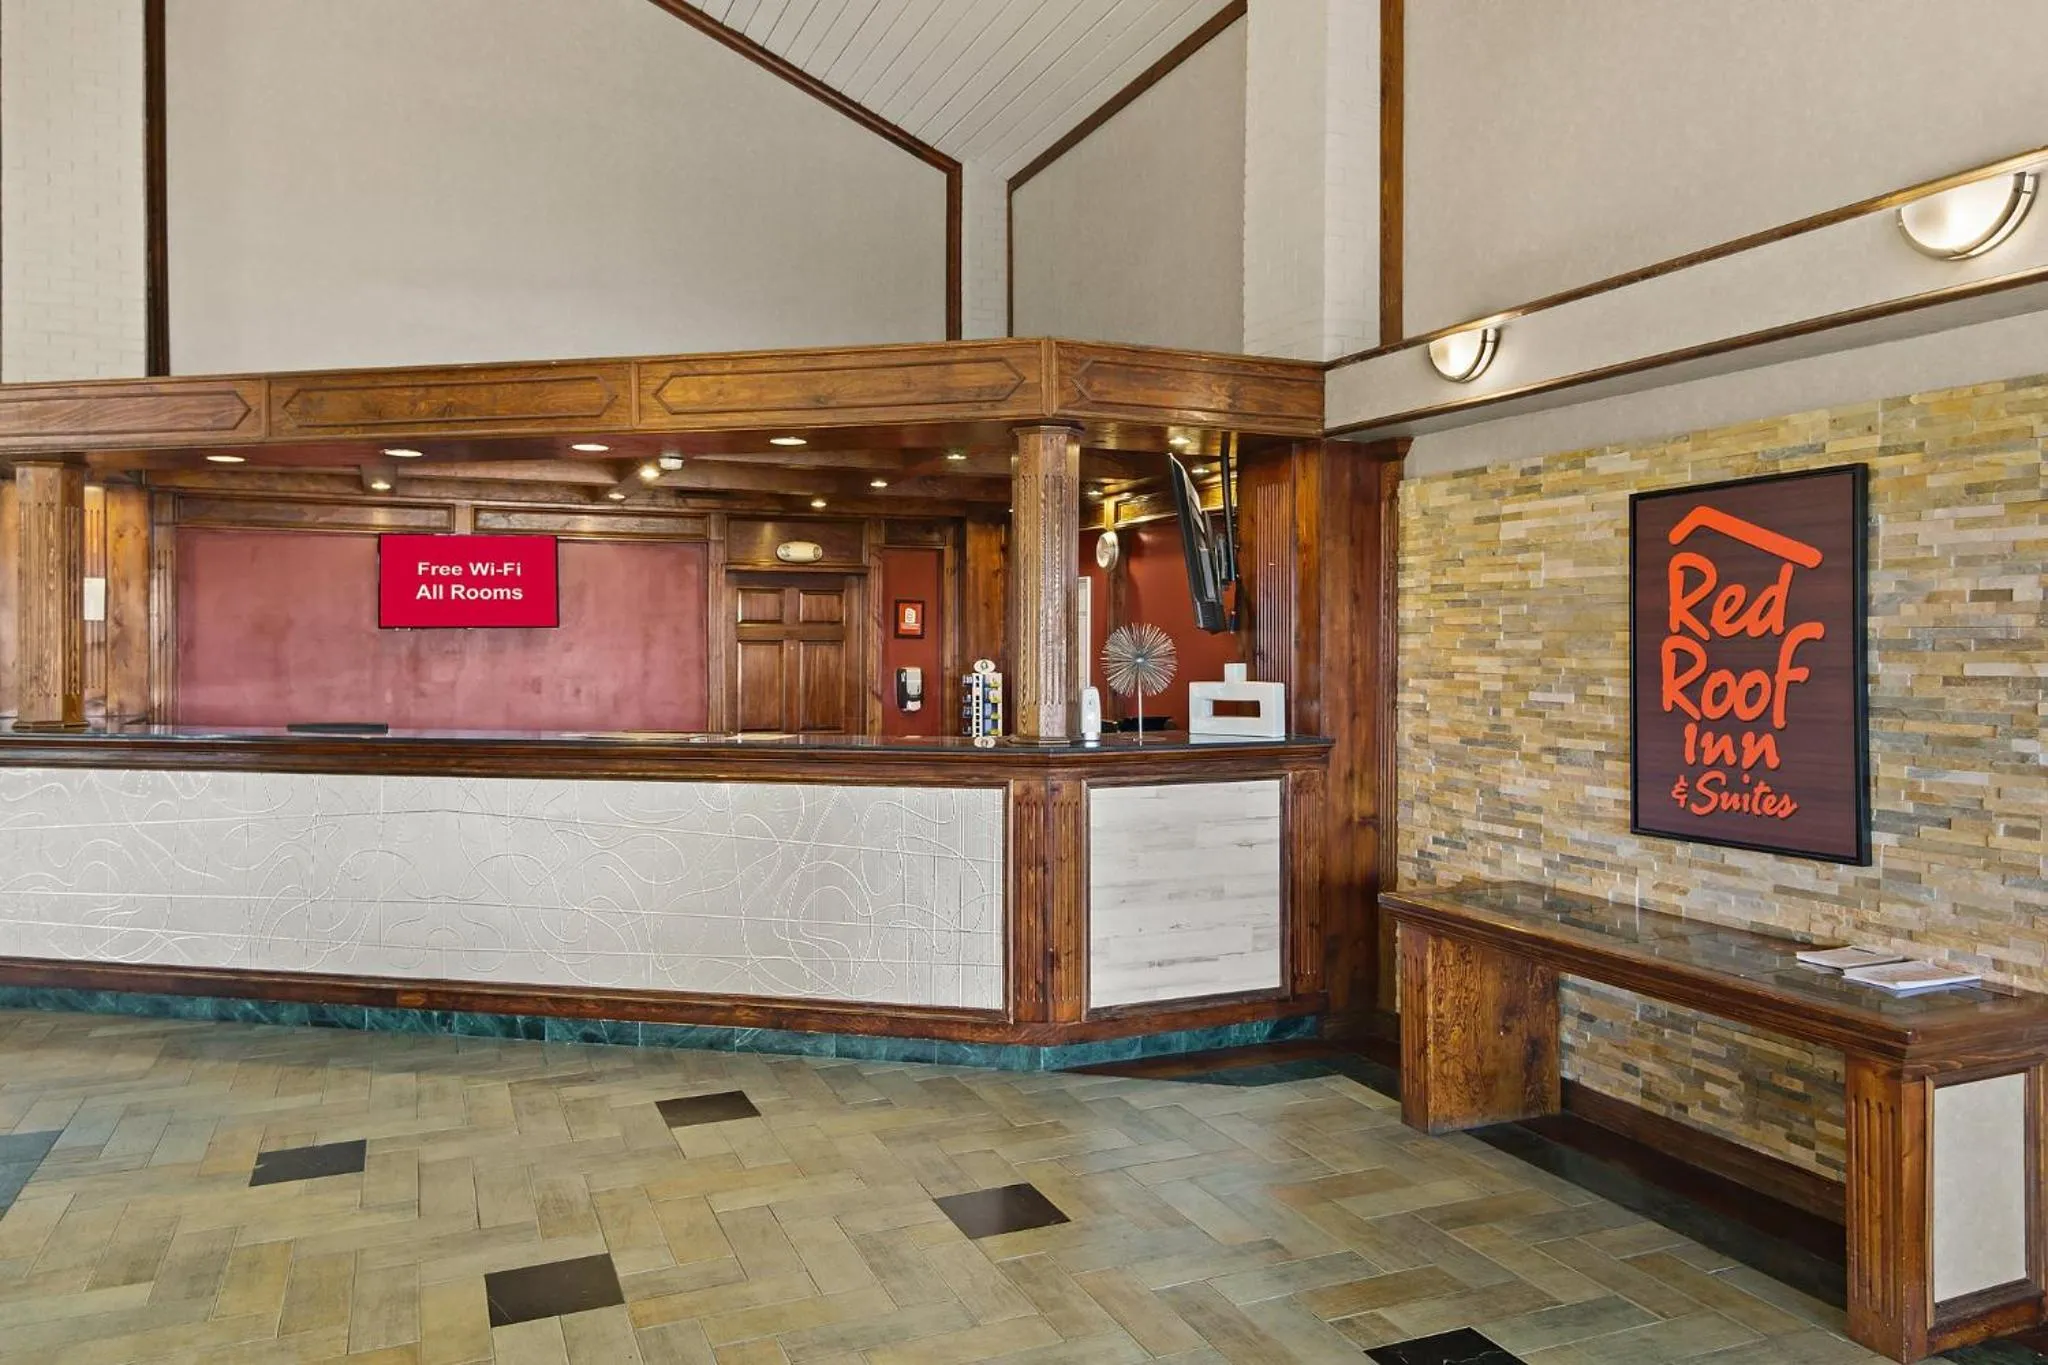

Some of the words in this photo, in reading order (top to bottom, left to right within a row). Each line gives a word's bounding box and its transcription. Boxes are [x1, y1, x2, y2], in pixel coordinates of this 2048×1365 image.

[416, 584, 444, 600] All
[451, 584, 523, 600] Rooms
[417, 562, 463, 576] Free
[469, 562, 522, 576] Wi-Fi
[1668, 552, 1794, 642] Red
[1661, 622, 1824, 729] Roof
[1684, 723, 1780, 770] Inn
[1671, 775, 1689, 809] &
[1690, 770, 1798, 818] Suites
